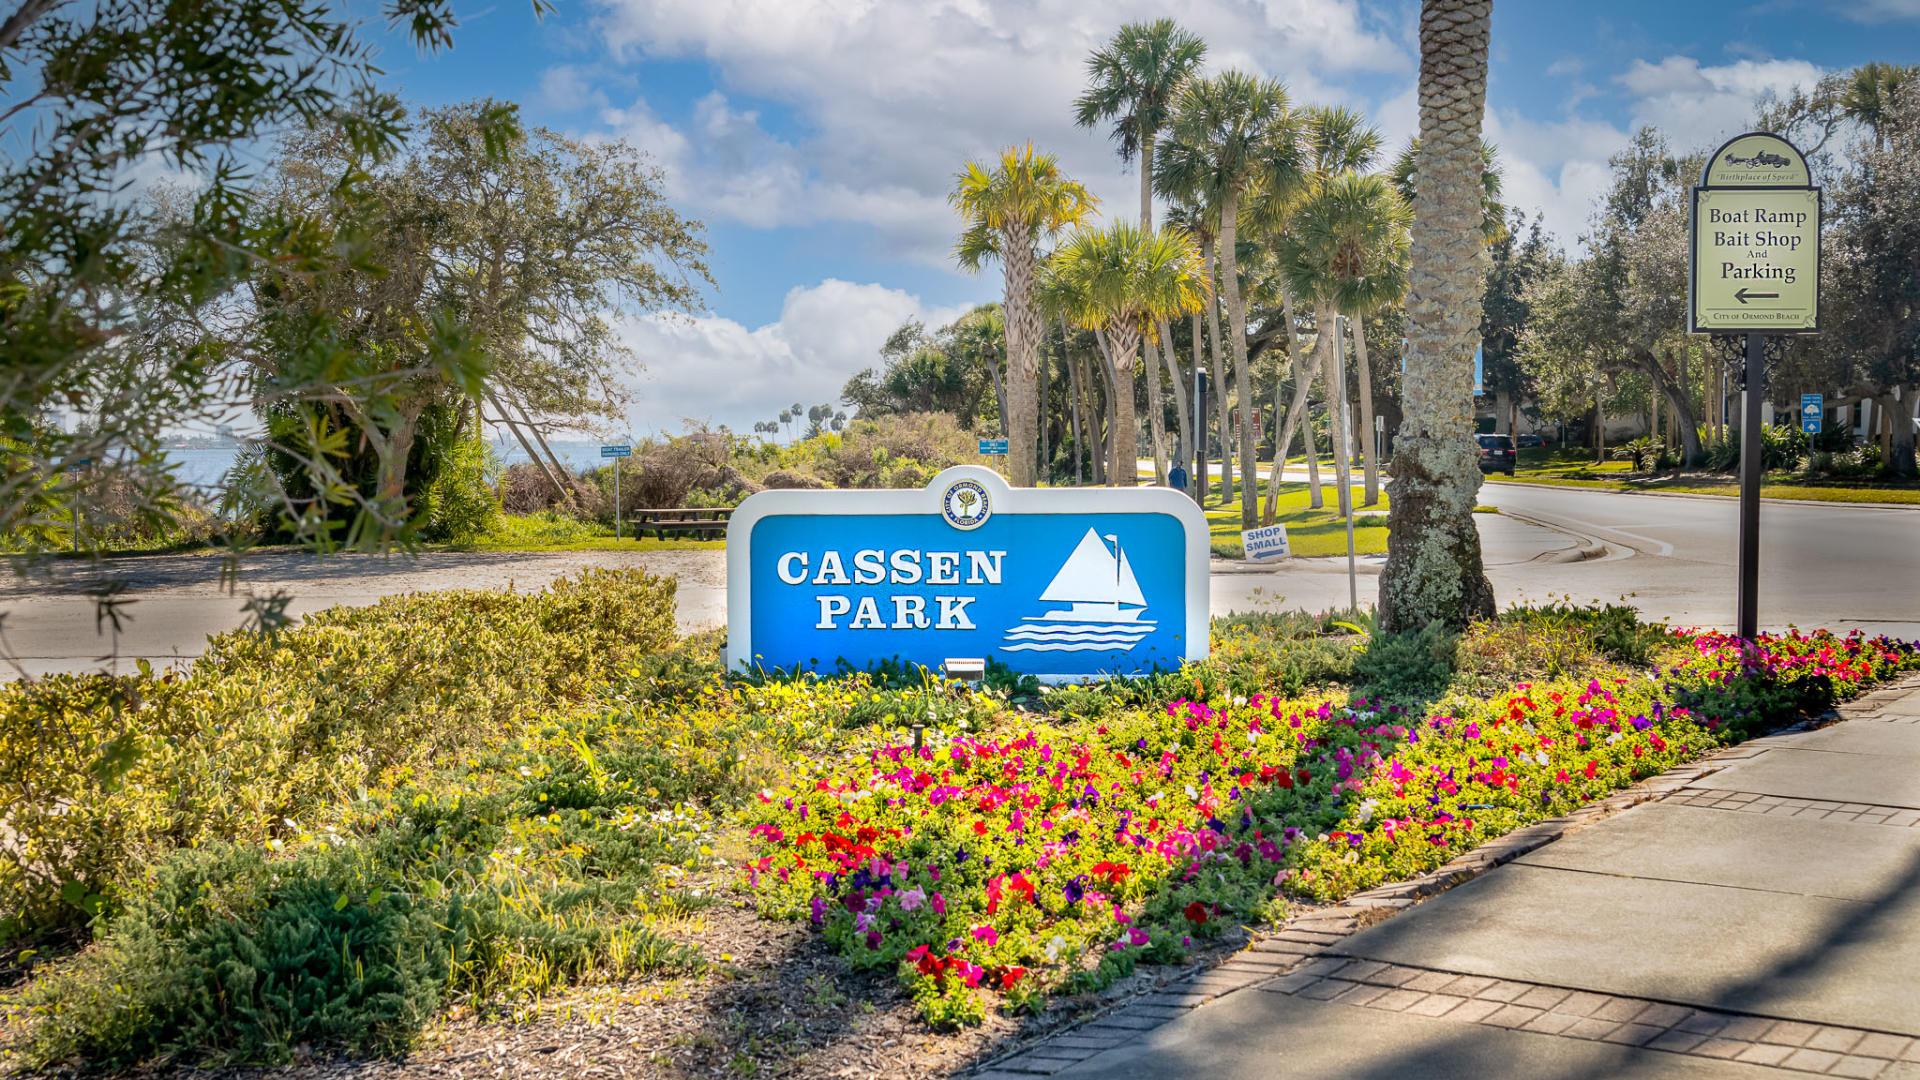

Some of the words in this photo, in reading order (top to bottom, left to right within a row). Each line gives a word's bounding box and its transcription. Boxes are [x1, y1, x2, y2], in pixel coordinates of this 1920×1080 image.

[1762, 172, 1771, 181] of
[1709, 208, 1749, 223] Boat
[1754, 208, 1807, 228] Ramp
[1714, 231, 1749, 246] Bait
[1755, 231, 1801, 251] Shop
[1747, 250, 1768, 258] And
[1721, 262, 1796, 284] Parking
[953, 482, 982, 492] ORMOND
[1248, 528, 1280, 540] SHOP
[1246, 537, 1286, 551] SMALL
[777, 549, 1007, 585] CASSEN
[815, 595, 977, 630] PARK
